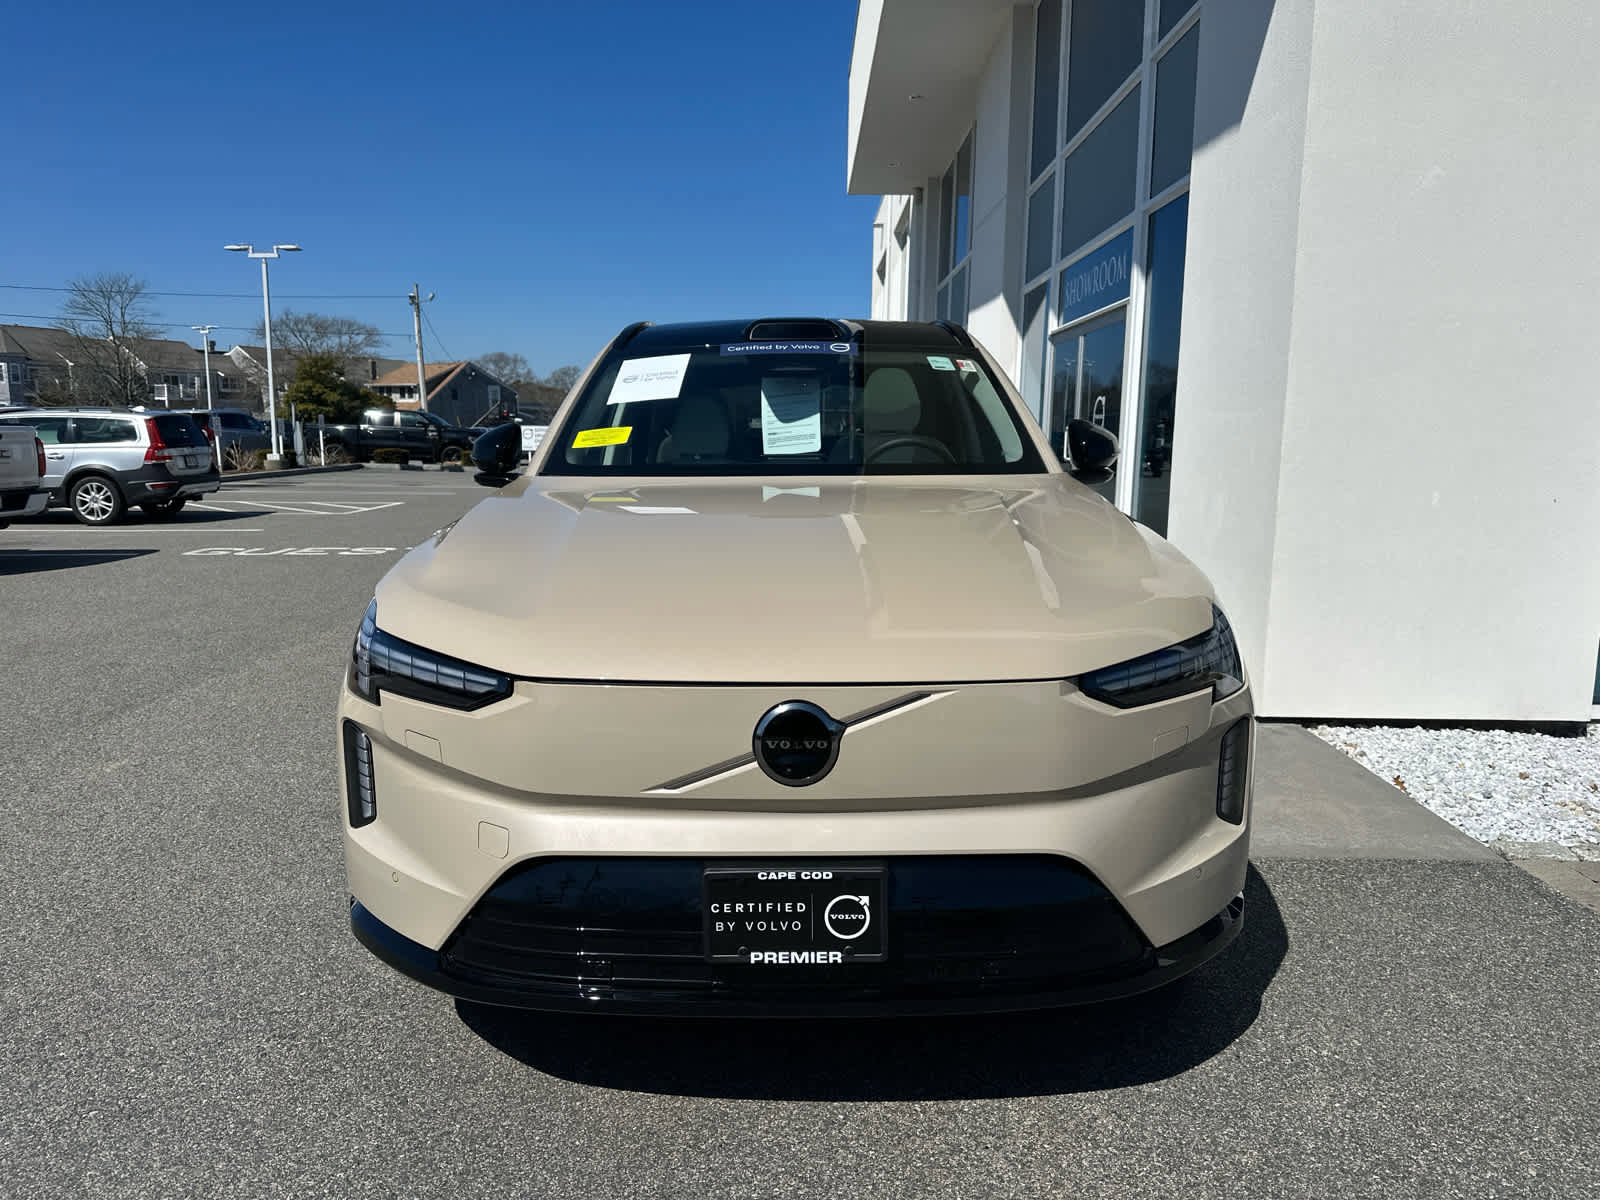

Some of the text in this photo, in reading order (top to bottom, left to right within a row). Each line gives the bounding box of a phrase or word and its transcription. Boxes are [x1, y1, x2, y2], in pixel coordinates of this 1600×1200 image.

[1065, 253, 1127, 308] SHOWROOM
[727, 344, 772, 352] Certified
[181, 547, 412, 556] GUES
[766, 740, 828, 749] VOLVO
[757, 871, 833, 880] CAPE COD
[710, 902, 806, 913] CERTIFIED
[715, 920, 802, 932] BY VOLVO
[750, 951, 842, 964] PREMIER
